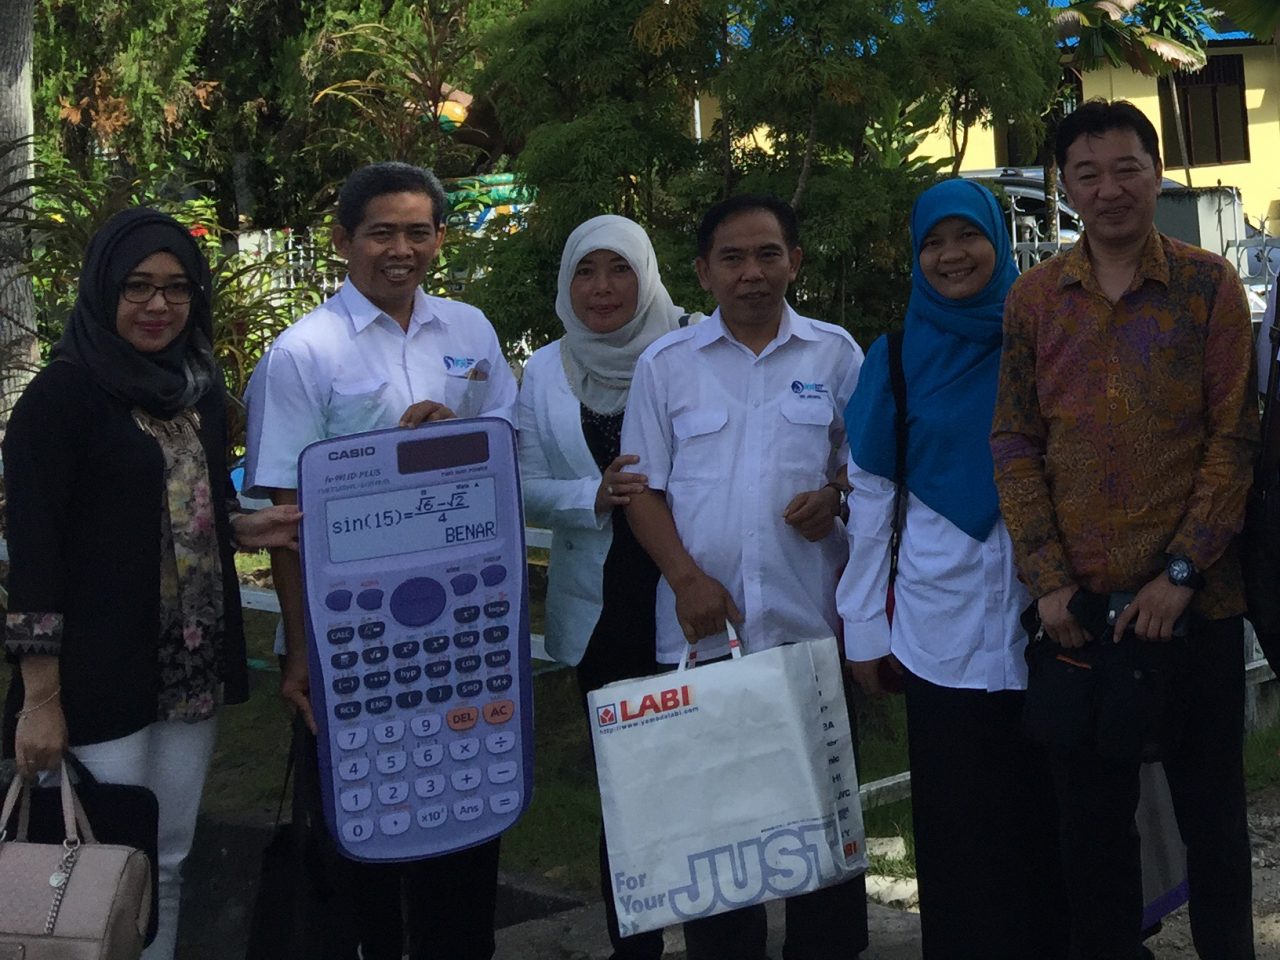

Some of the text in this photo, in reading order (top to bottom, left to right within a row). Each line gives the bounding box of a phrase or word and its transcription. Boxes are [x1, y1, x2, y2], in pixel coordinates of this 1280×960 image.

[328, 446, 376, 461] CASIO
[437, 512, 448, 523] 4
[445, 521, 496, 544] BENAR
[400, 668, 417, 679] hyp
[620, 685, 690, 722] LABI
[453, 712, 474, 724] DEL
[490, 706, 508, 717] AC
[385, 726, 394, 738] 8
[421, 719, 431, 732] 9
[347, 732, 357, 745] 7
[387, 755, 396, 768] 5
[423, 749, 433, 761] 6
[349, 763, 359, 775] 4
[426, 779, 435, 792] 3
[389, 786, 398, 799] 2
[352, 794, 359, 806] 1
[459, 804, 479, 815] Ans
[352, 824, 363, 837] 0
[619, 822, 839, 920] Your JUST
[614, 871, 647, 893] For
